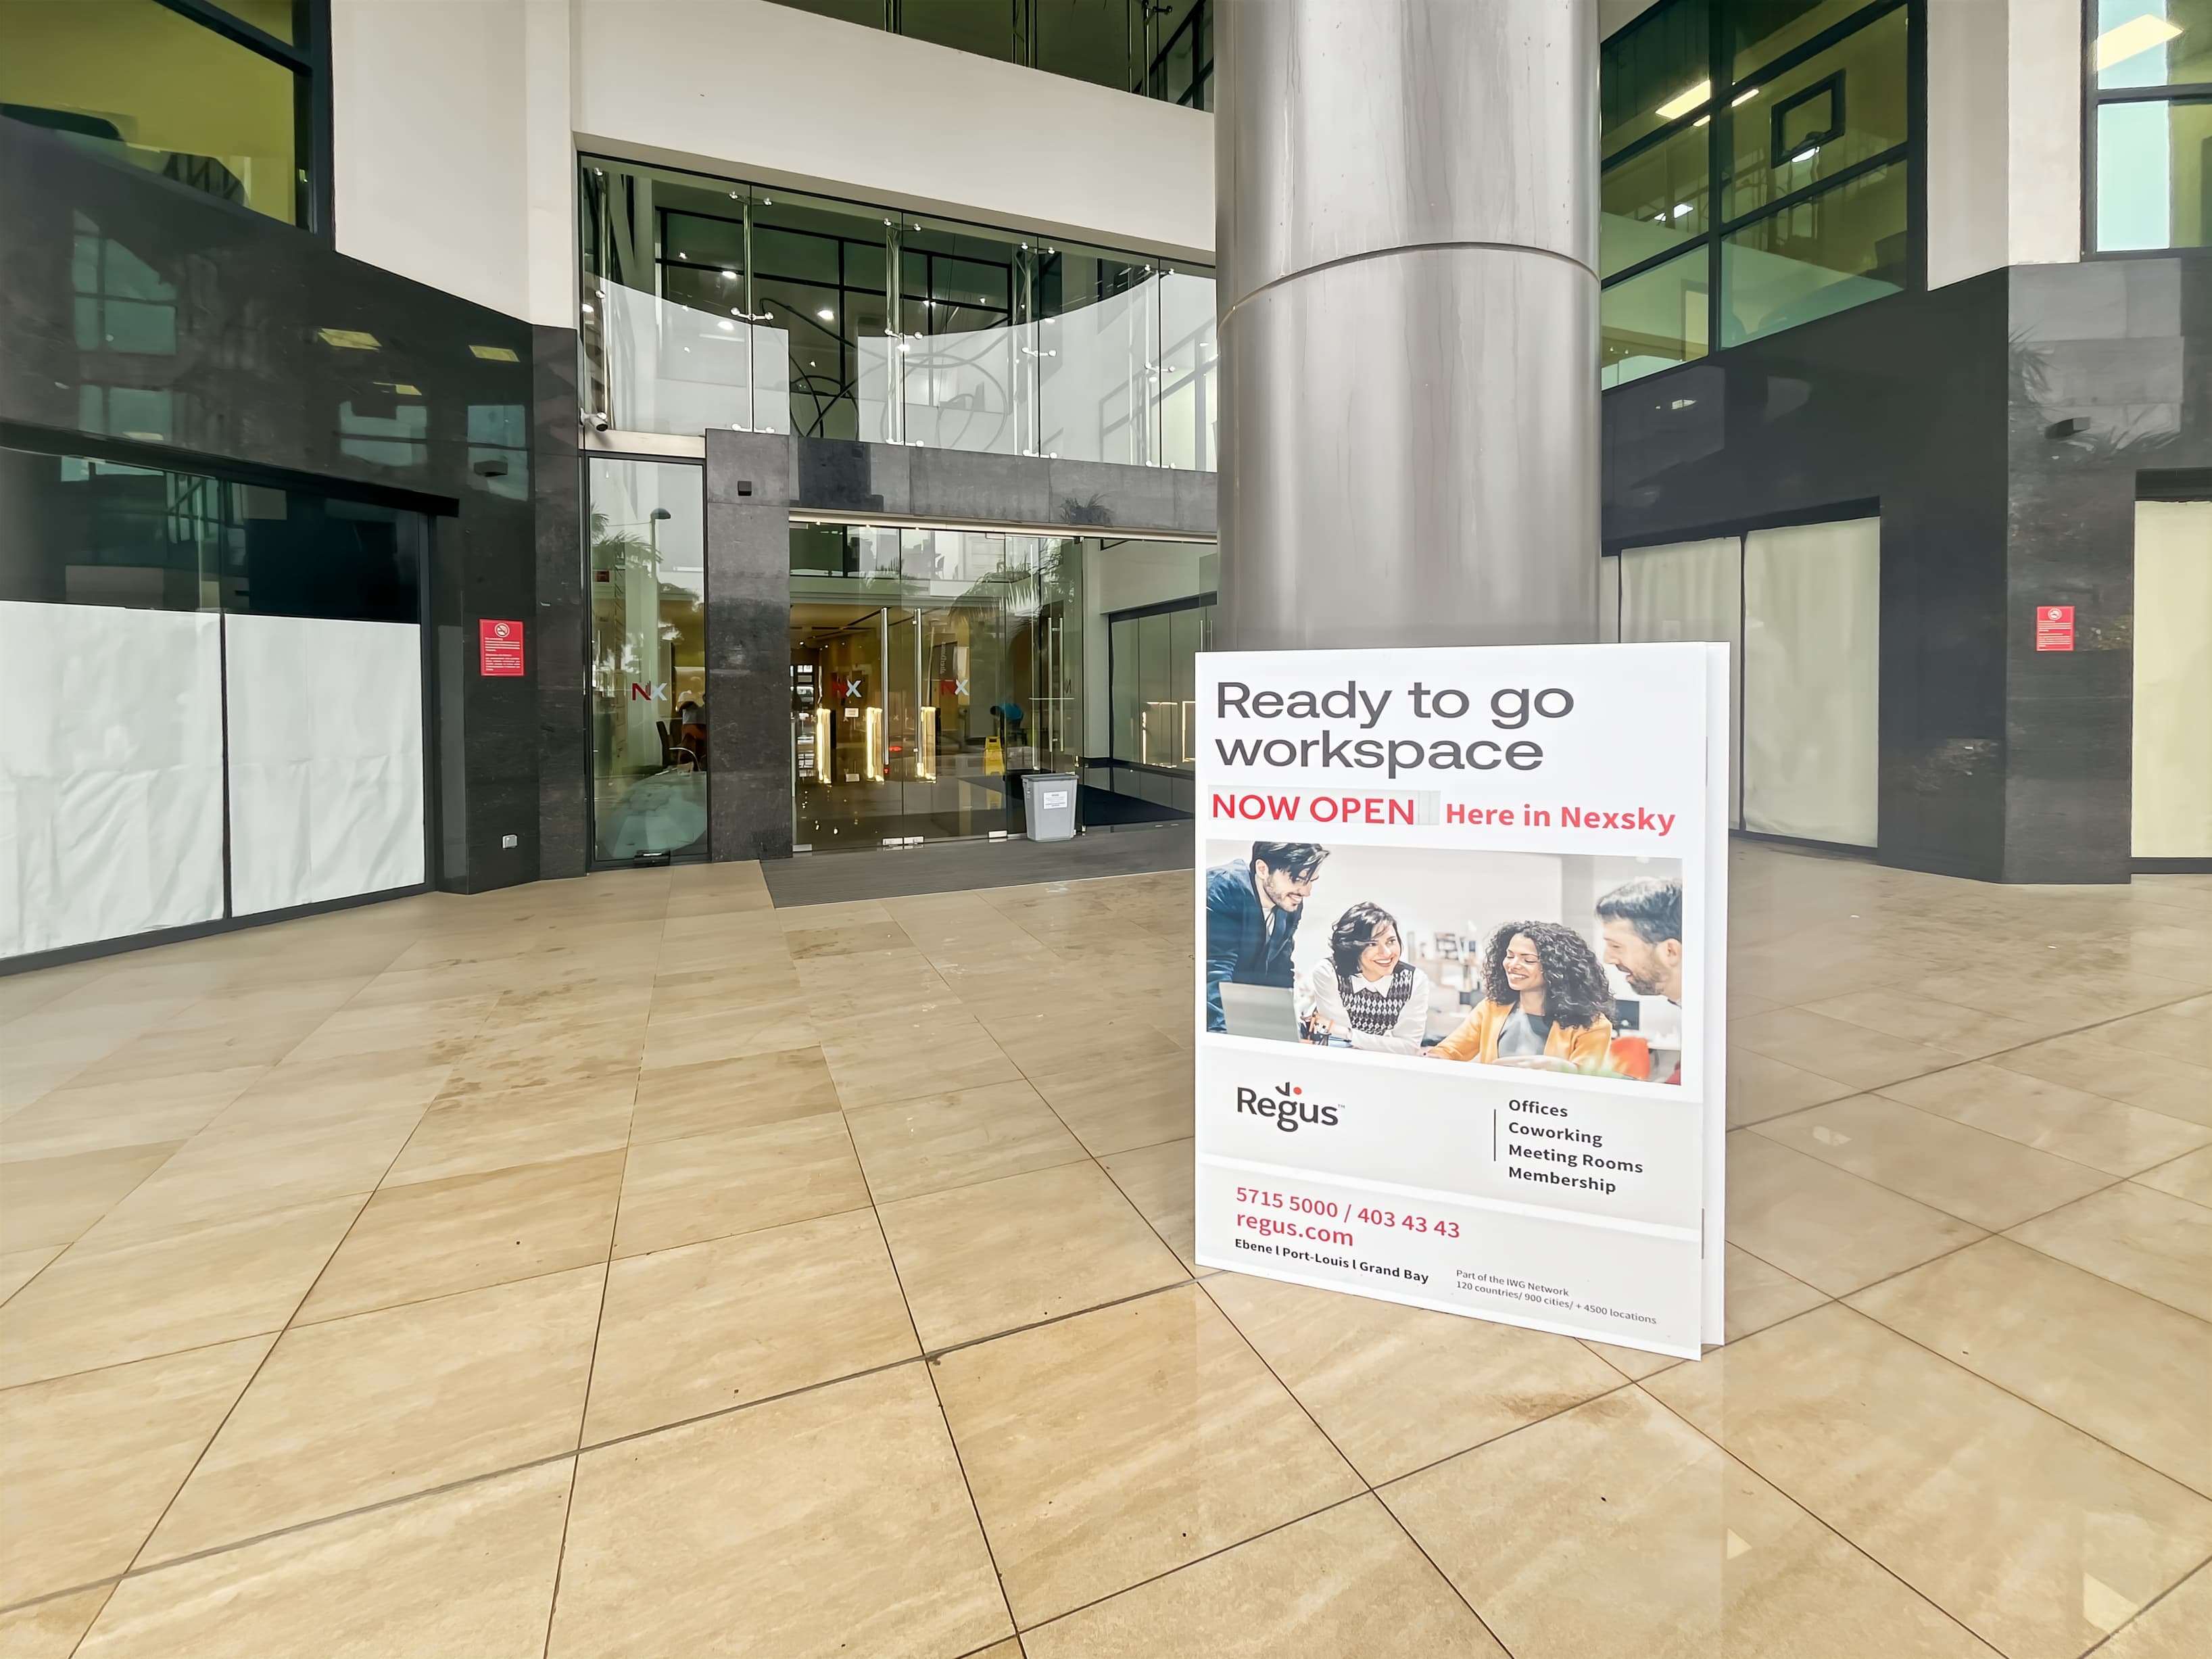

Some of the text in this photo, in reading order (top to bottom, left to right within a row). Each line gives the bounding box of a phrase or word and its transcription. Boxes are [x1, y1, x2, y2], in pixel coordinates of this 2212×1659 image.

[1217, 681, 1575, 729] Ready to go
[1215, 730, 1544, 779] workspace
[1212, 793, 1415, 825] NOW OPEN
[1446, 803, 1677, 837] Here in Nexsky
[1236, 1082, 1339, 1133] Regus
[1508, 1099, 1568, 1117] Offices
[1508, 1122, 1604, 1148] Coworking
[1508, 1144, 1643, 1173] Meeting Rooms
[1508, 1166, 1616, 1195] Membership
[1236, 1186, 1460, 1239] 5715 5000 / 403 43 43
[1236, 1213, 1353, 1247] regus.com
[1234, 1239, 1272, 1254] Ebene
[1282, 1247, 1349, 1269] Port-Louis
[1360, 1261, 1400, 1277] Grand
[1403, 1269, 1429, 1284] Bay
[1456, 1270, 1570, 1297] Part of the IWG Network
[1457, 1281, 1473, 1291] 120
[1474, 1286, 1522, 1300] countries/
[1524, 1293, 1542, 1303] 900
[1544, 1297, 1574, 1310] cities/
[1584, 1304, 1608, 1315] 4500
[1610, 1308, 1657, 1324] locations
